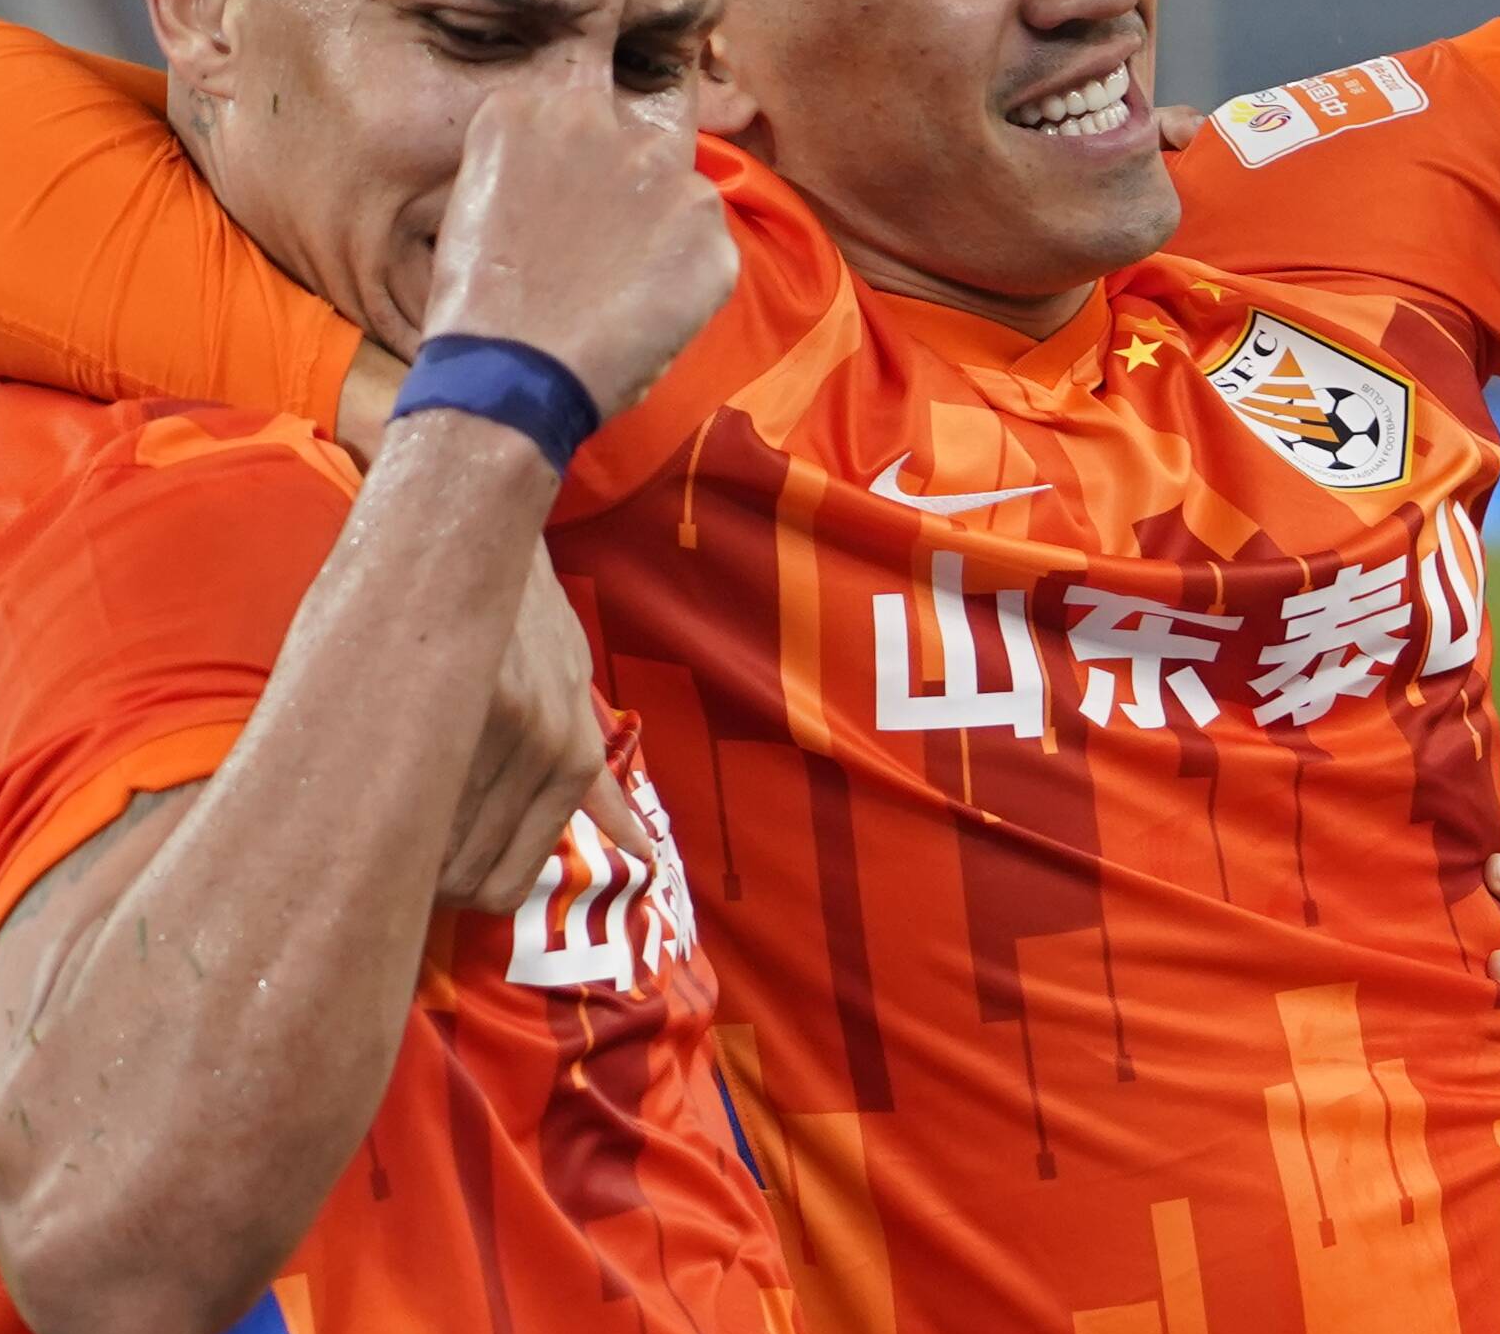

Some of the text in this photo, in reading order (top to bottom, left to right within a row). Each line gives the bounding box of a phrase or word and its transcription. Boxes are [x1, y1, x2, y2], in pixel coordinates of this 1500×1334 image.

[1297, 76, 1348, 116] 中国
[1360, 383, 1382, 405] CLUB
[1382, 403, 1396, 458] FOOTBALL
